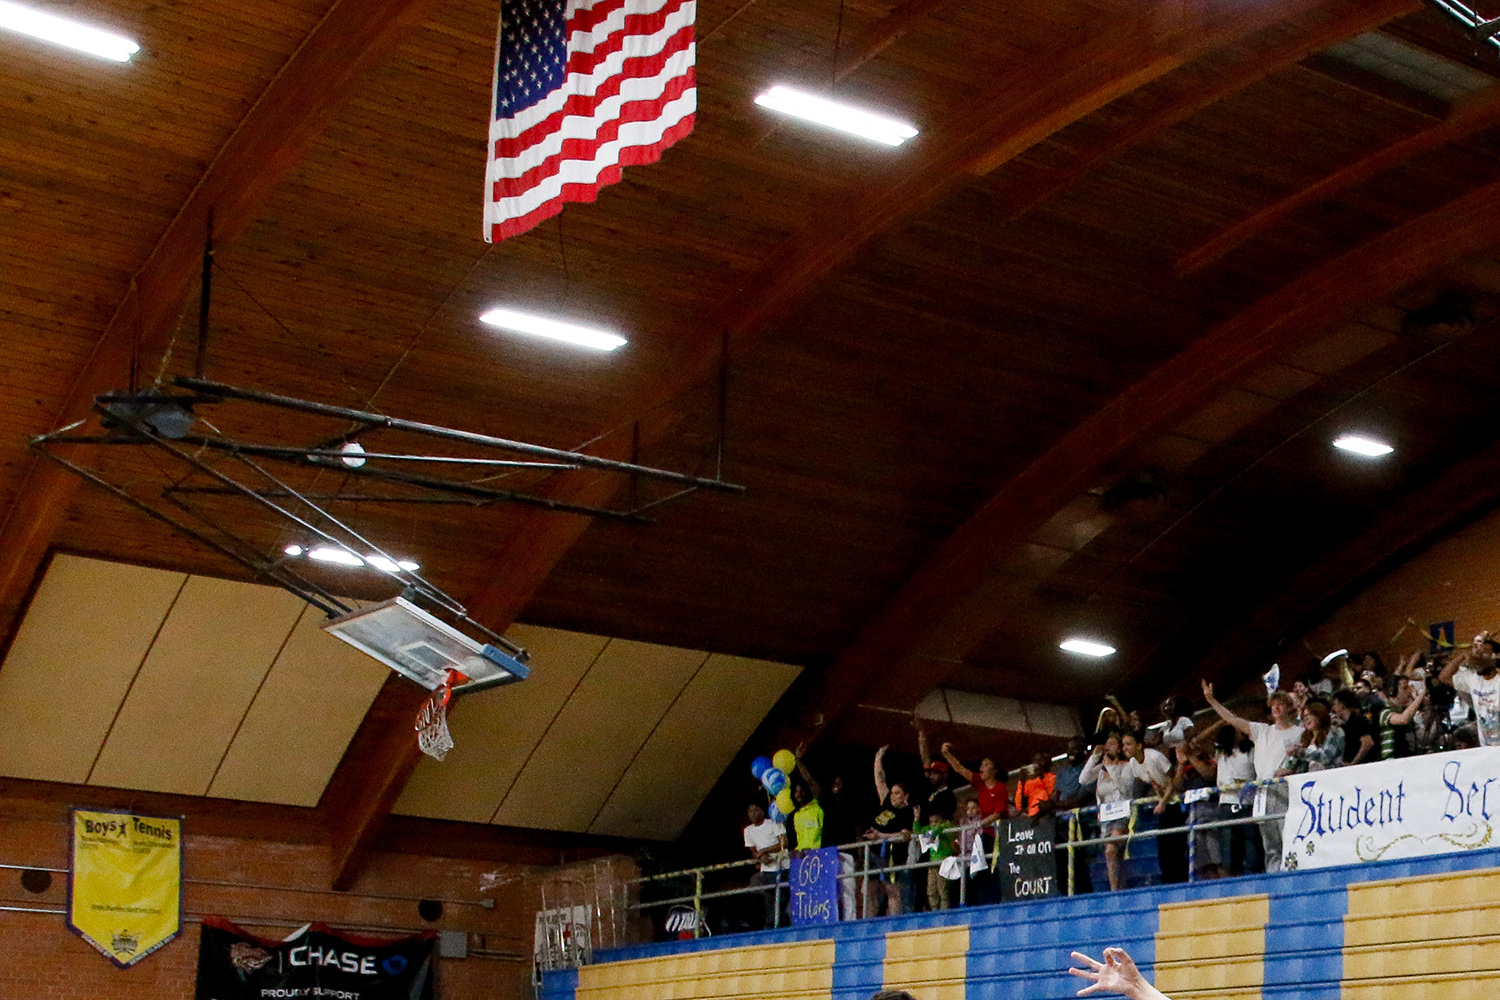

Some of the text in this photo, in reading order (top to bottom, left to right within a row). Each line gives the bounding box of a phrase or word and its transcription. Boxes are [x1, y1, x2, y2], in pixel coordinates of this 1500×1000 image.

[1293, 780, 1405, 844] Student
[84, 817, 172, 840] Boys Tennis
[1008, 823, 1034, 842] Leave
[800, 855, 821, 886] GO
[1015, 877, 1052, 897] COURT
[796, 891, 830, 920] Titans
[289, 945, 378, 975] CHASE
[313, 987, 360, 1000] SUPPORT
